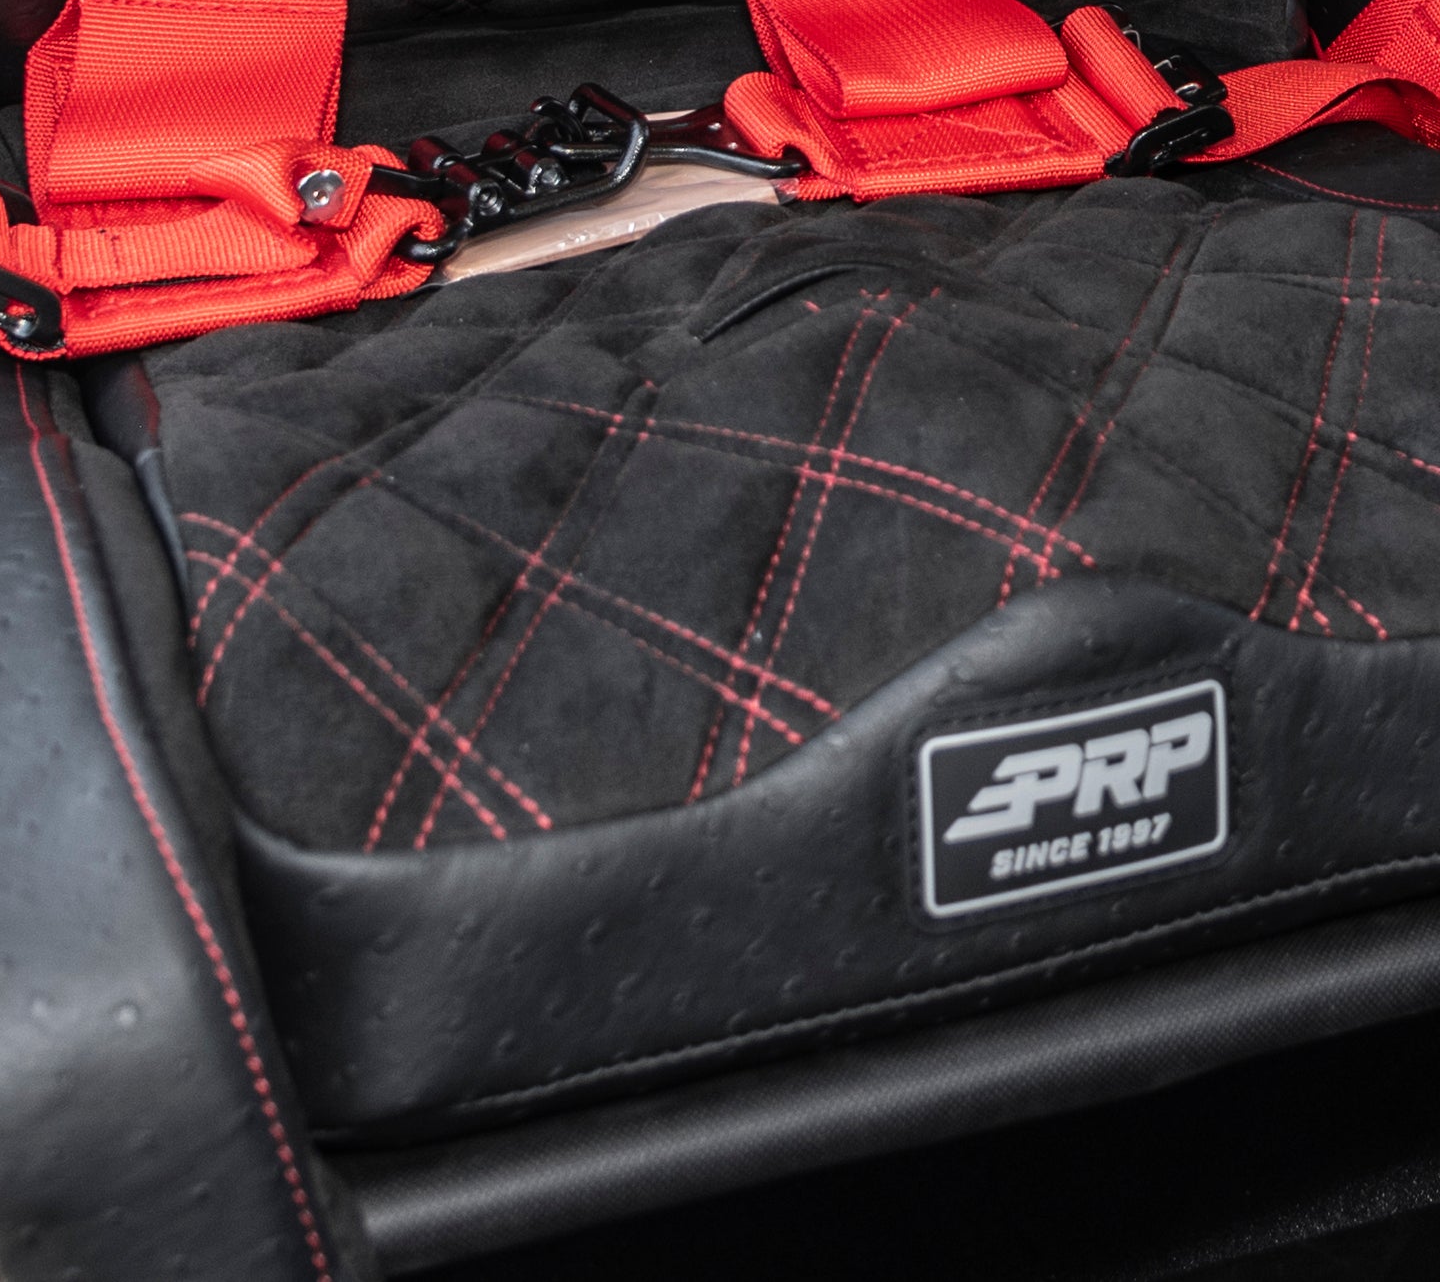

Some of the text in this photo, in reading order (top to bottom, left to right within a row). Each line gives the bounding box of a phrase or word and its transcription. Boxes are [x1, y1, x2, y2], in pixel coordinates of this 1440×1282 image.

[943, 711, 1213, 844] PRP
[989, 812, 1172, 880] SINCE 1997
